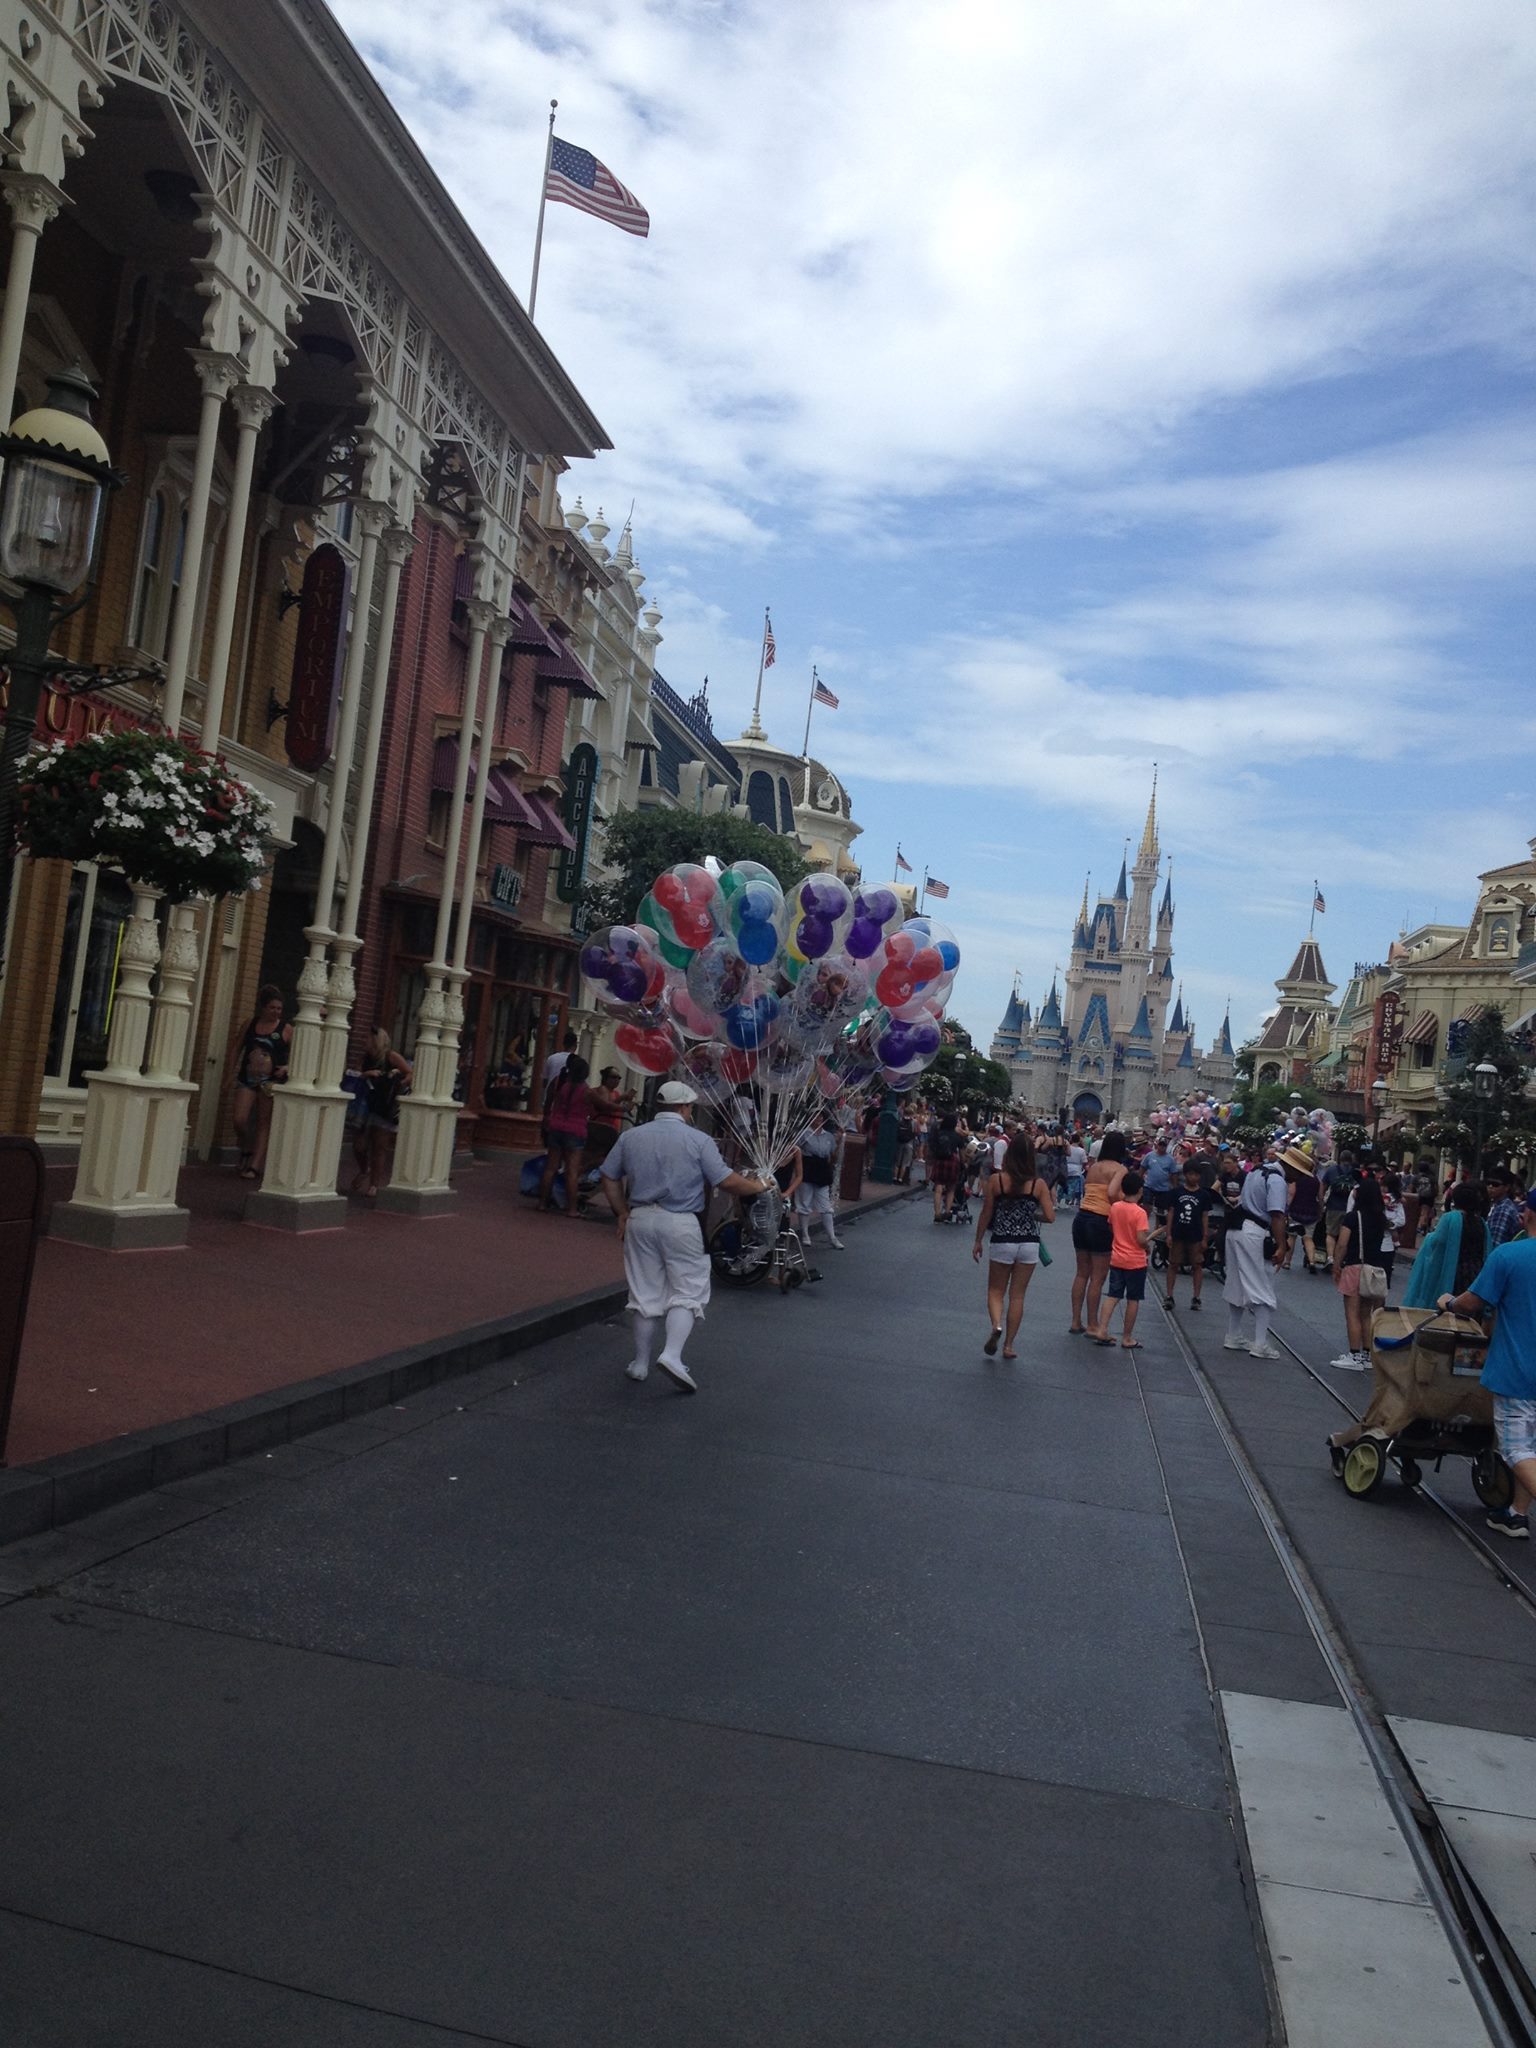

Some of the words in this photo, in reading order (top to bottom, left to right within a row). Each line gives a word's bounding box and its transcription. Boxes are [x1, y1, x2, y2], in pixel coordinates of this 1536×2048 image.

[296, 569, 336, 740] EMPORIUM
[563, 757, 588, 889] ARCADE
[496, 865, 525, 905] GIFTS
[1383, 1002, 1394, 1038] CRYSTAL
[1380, 1042, 1390, 1063] ARTS
